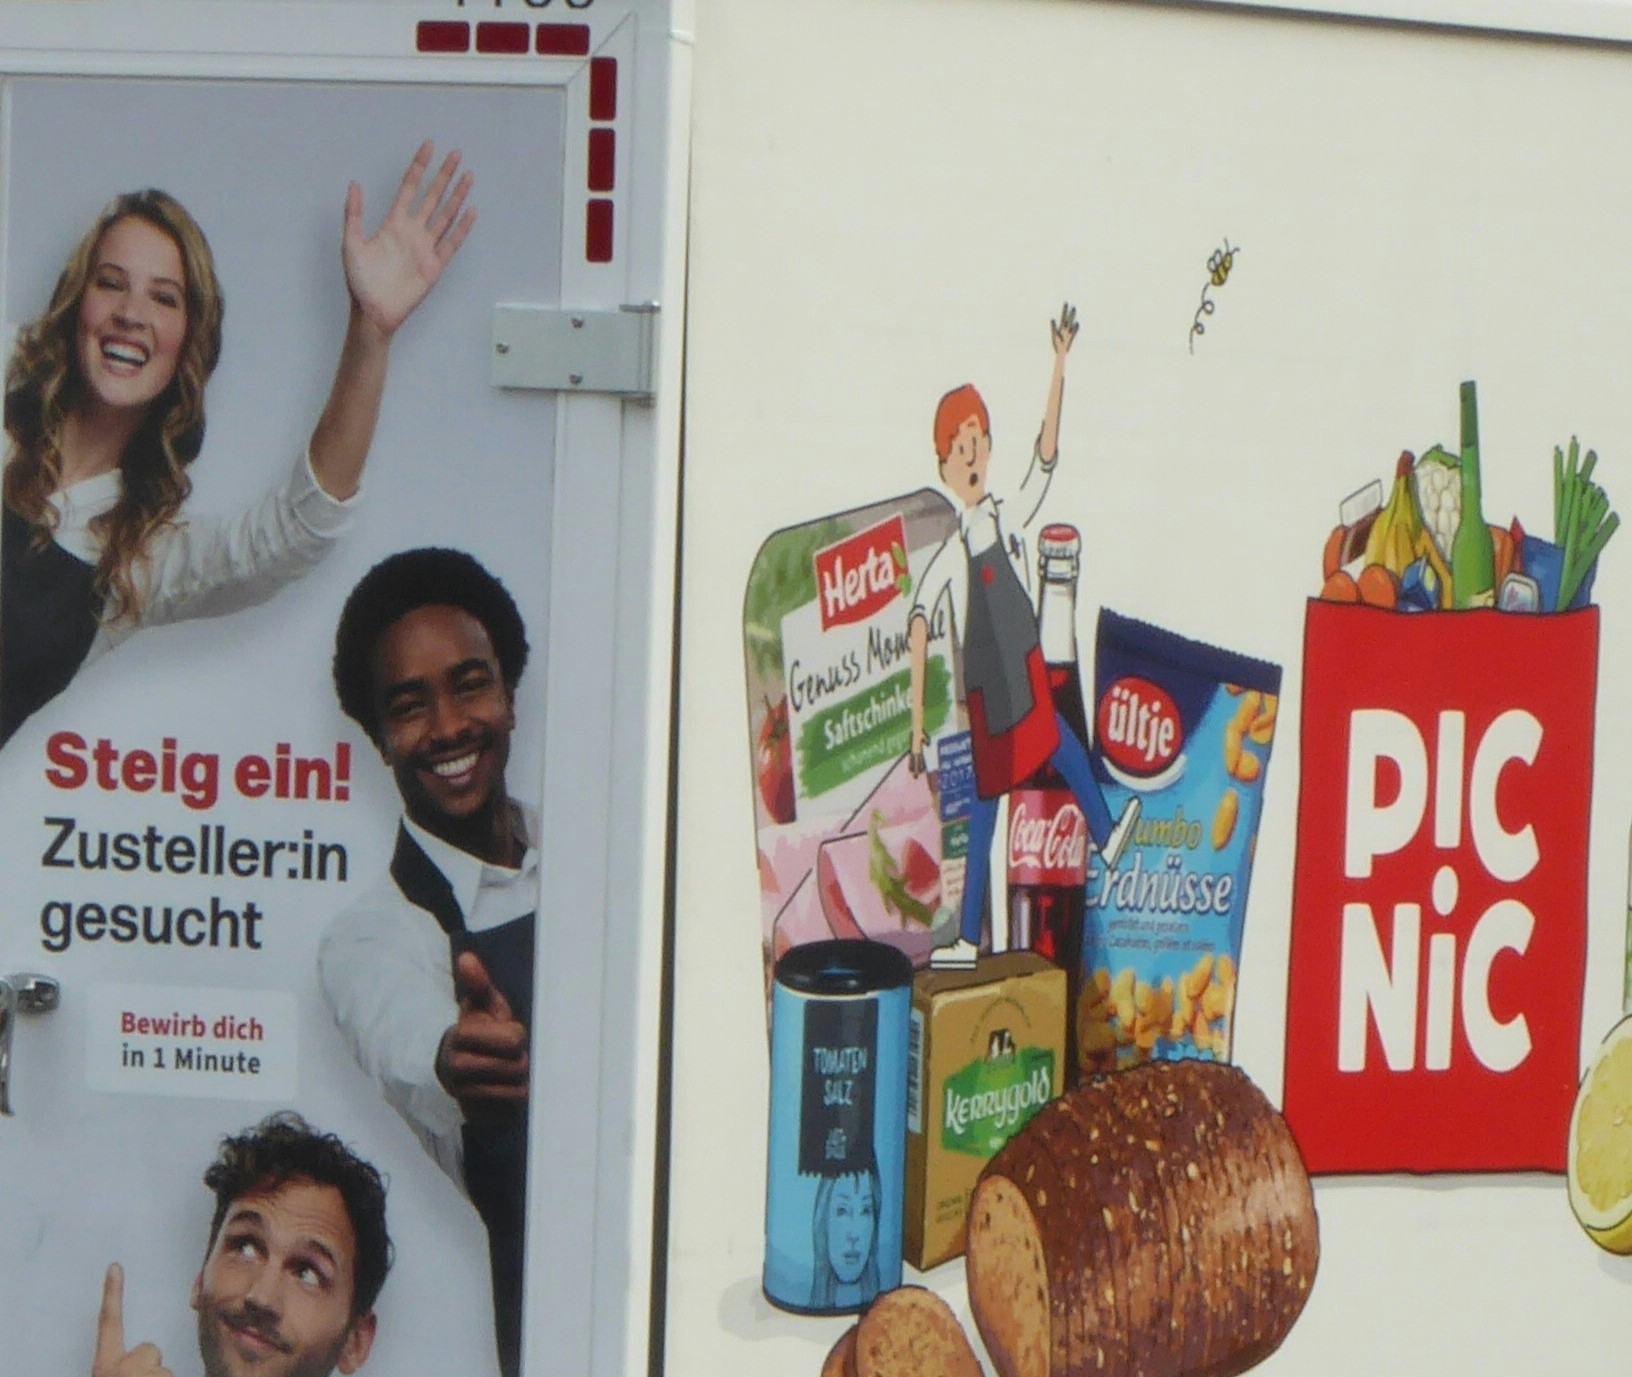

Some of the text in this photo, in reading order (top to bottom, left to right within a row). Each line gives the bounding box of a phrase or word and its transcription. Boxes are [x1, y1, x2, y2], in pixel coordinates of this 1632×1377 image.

[822, 546, 896, 619] Herta
[789, 650, 861, 713] Genuss
[1108, 685, 1175, 762] ültje
[44, 731, 352, 811] Steig ein!
[1344, 708, 1544, 883] PIC
[41, 816, 349, 882] Zusteller:in
[1133, 804, 1202, 849] umbo
[40, 896, 263, 953] gesucht
[121, 1011, 264, 1041] Bewirb dich
[122, 1044, 262, 1075] in 1 Minute
